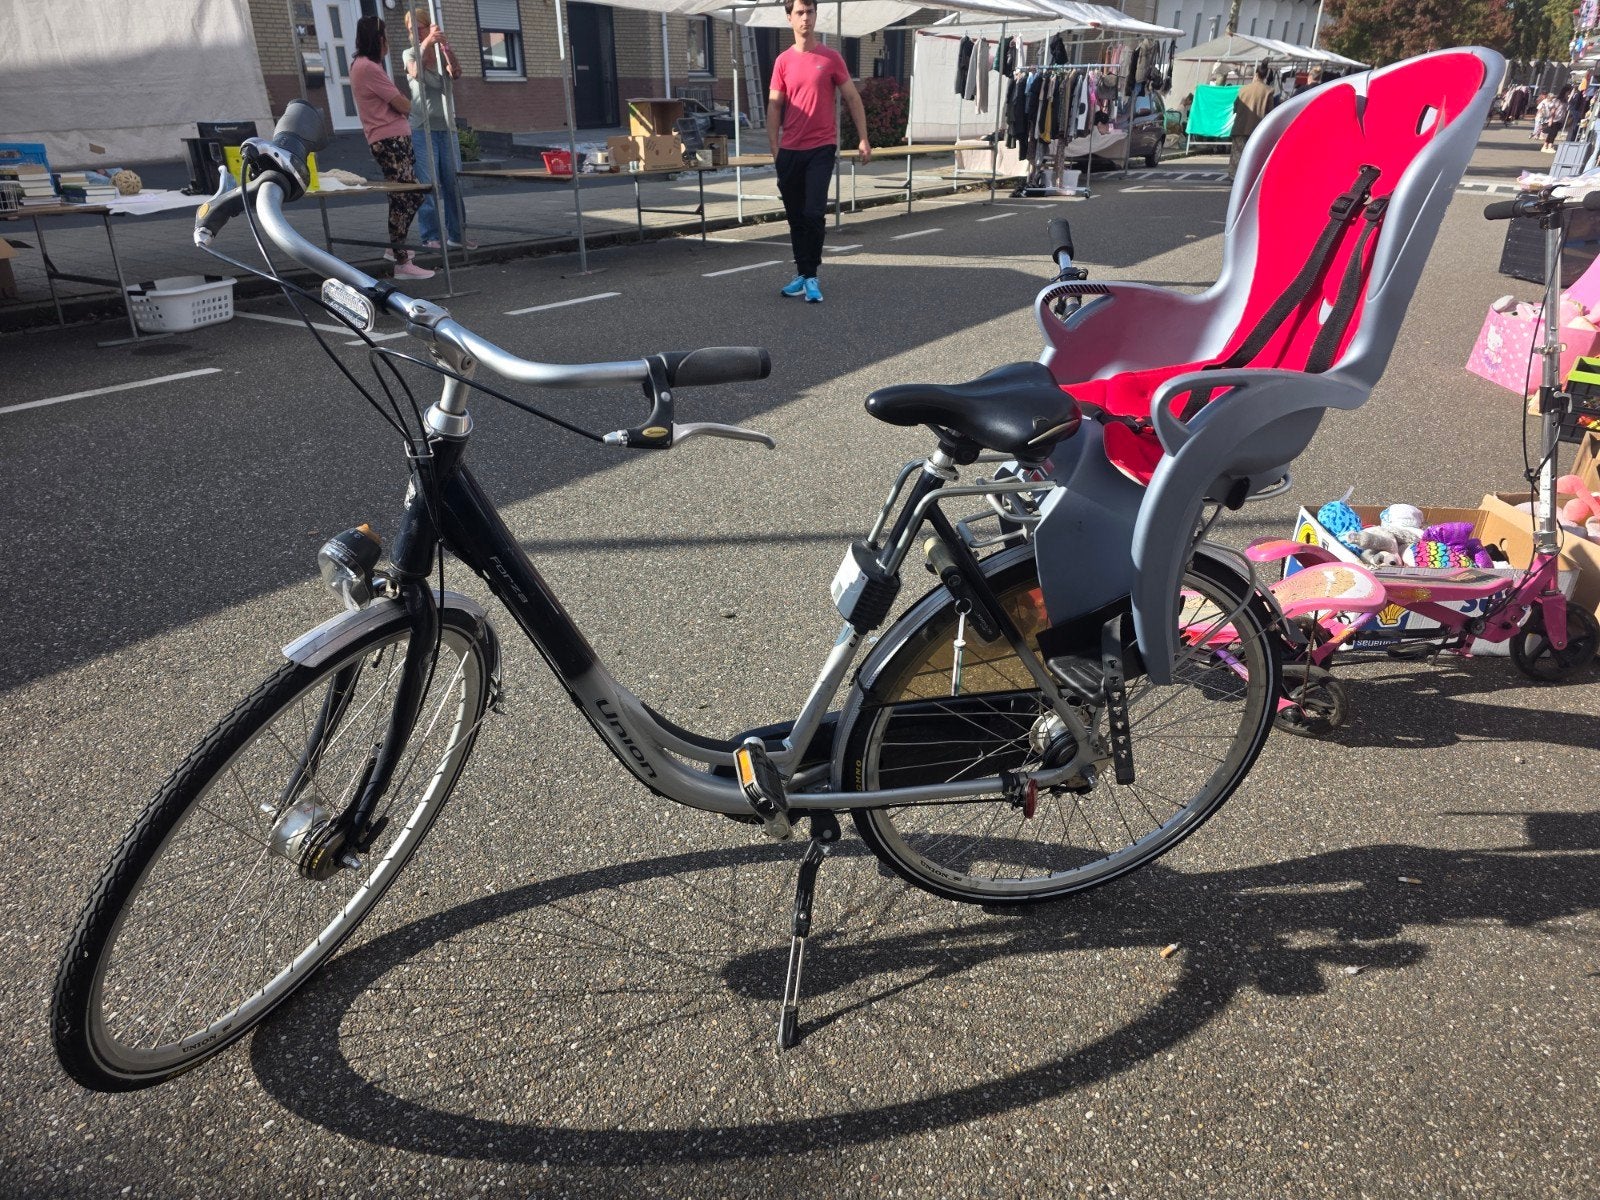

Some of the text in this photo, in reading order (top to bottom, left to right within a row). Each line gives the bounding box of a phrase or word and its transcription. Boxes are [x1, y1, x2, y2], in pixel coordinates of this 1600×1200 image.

[489, 556, 529, 603] Forza
[596, 698, 657, 779] Union
[920, 860, 949, 879] UNION
[182, 1034, 217, 1053] UNION
